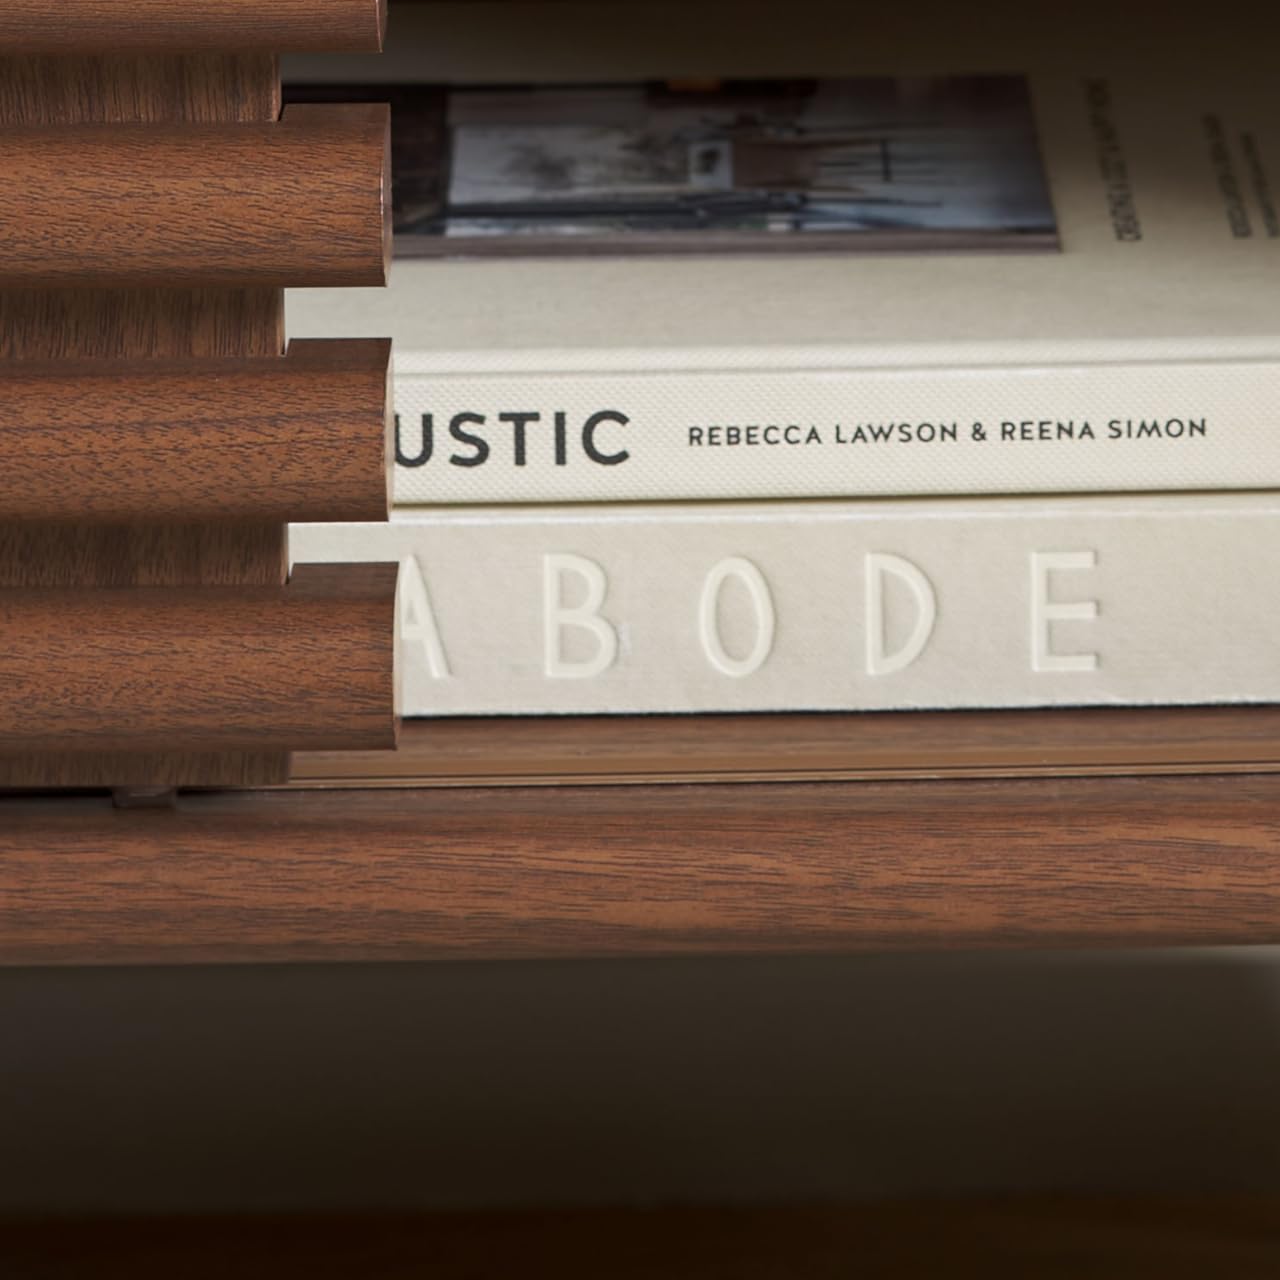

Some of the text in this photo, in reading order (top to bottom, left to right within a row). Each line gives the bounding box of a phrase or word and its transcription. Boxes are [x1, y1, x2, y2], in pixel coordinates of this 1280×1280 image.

[688, 418, 1206, 446] REBECCA LAWSON & REENA SIMON
[400, 552, 1101, 678] ABODE
